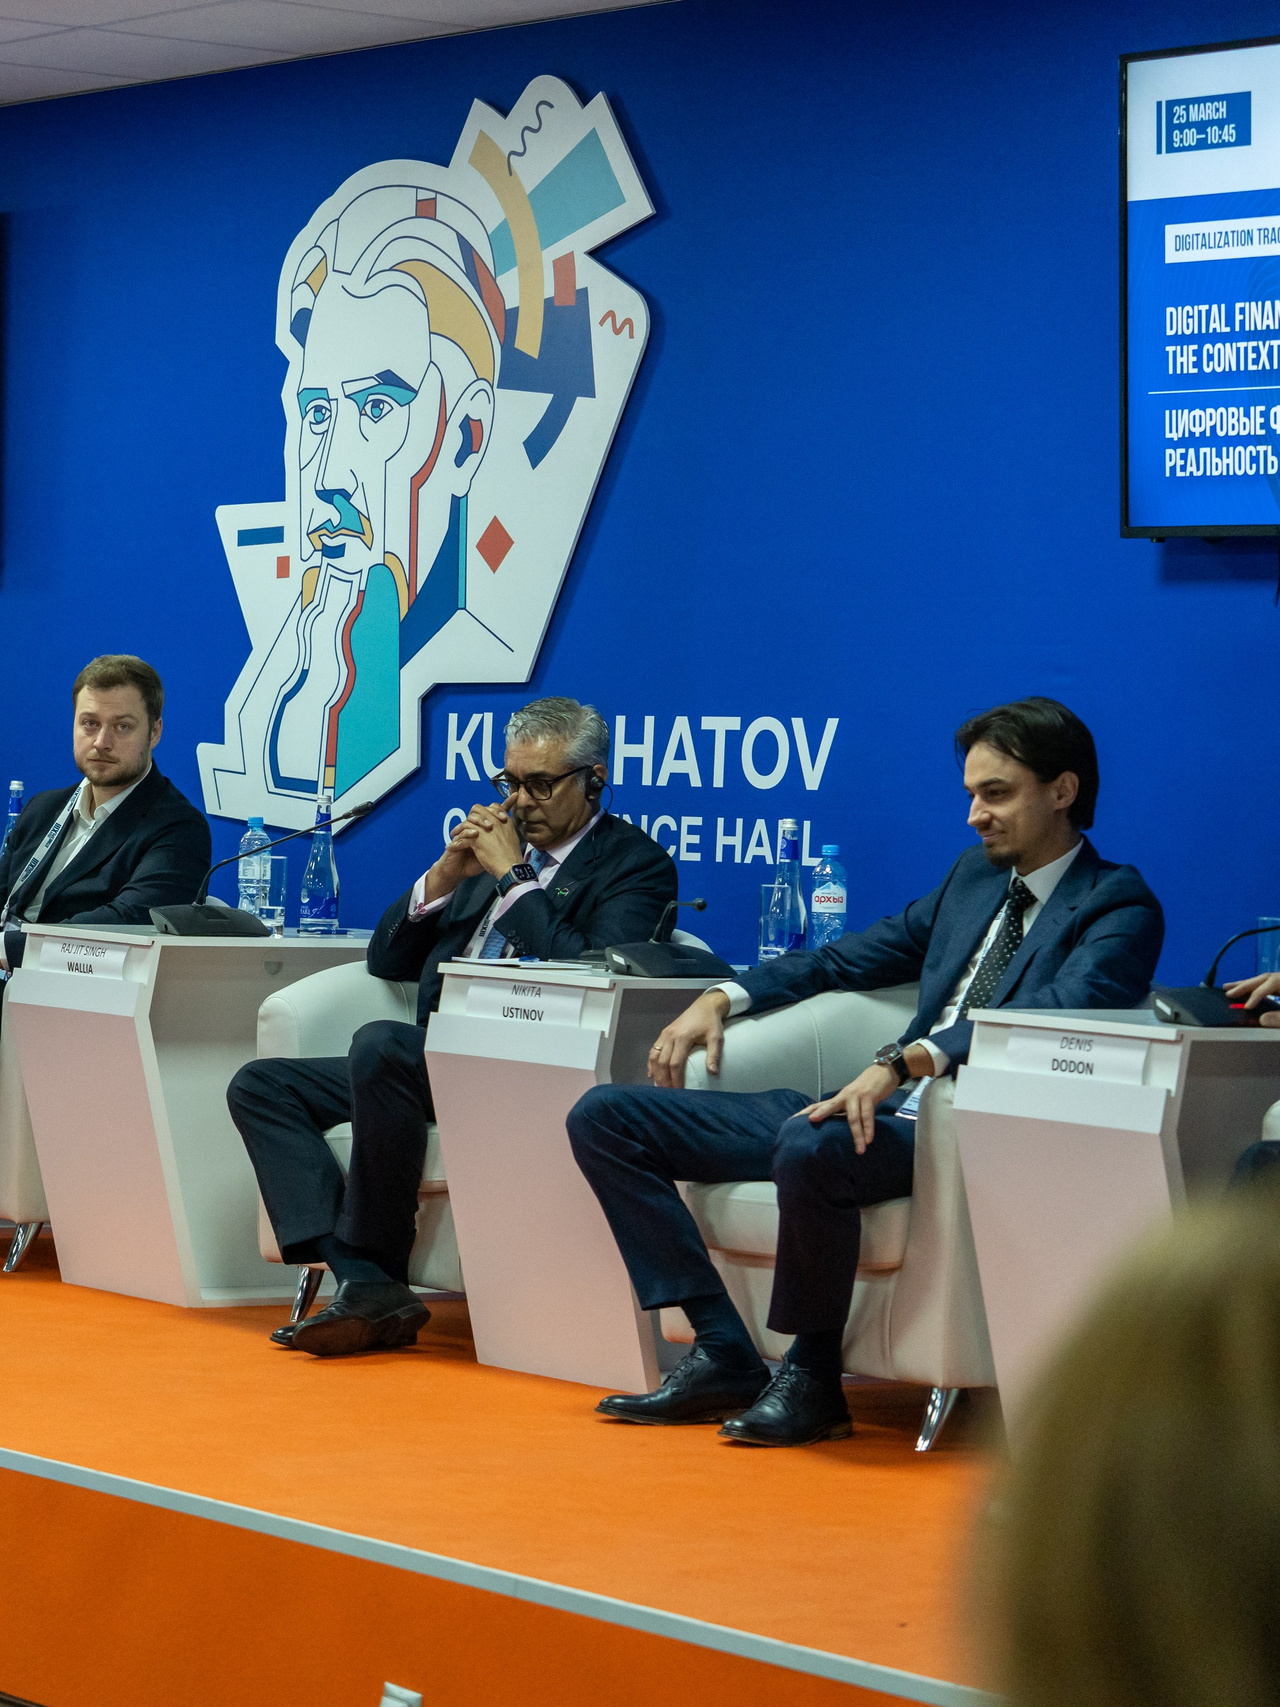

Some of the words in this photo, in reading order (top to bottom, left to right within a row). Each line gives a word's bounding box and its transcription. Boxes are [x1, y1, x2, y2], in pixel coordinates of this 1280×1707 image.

[1174, 105, 1187, 124] 25
[1189, 101, 1227, 122] MARCH
[1175, 229, 1254, 252] DIGITALIZATION
[1166, 303, 1231, 336] DIGITAL
[1166, 344, 1198, 375] THE
[1203, 340, 1280, 373] CONTEXT
[1165, 405, 1266, 441] ЦИФРОВЫЕ
[1165, 445, 1279, 478] РЕАЛЬНОСТЬ
[445, 711, 840, 791] KUHATOV
[84, 946, 107, 958] SINGH
[512, 985, 542, 999] NIKITA
[503, 1006, 544, 1022] USTINOV
[1060, 1037, 1094, 1052] DENIS
[1052, 1059, 1094, 1076] DODON
